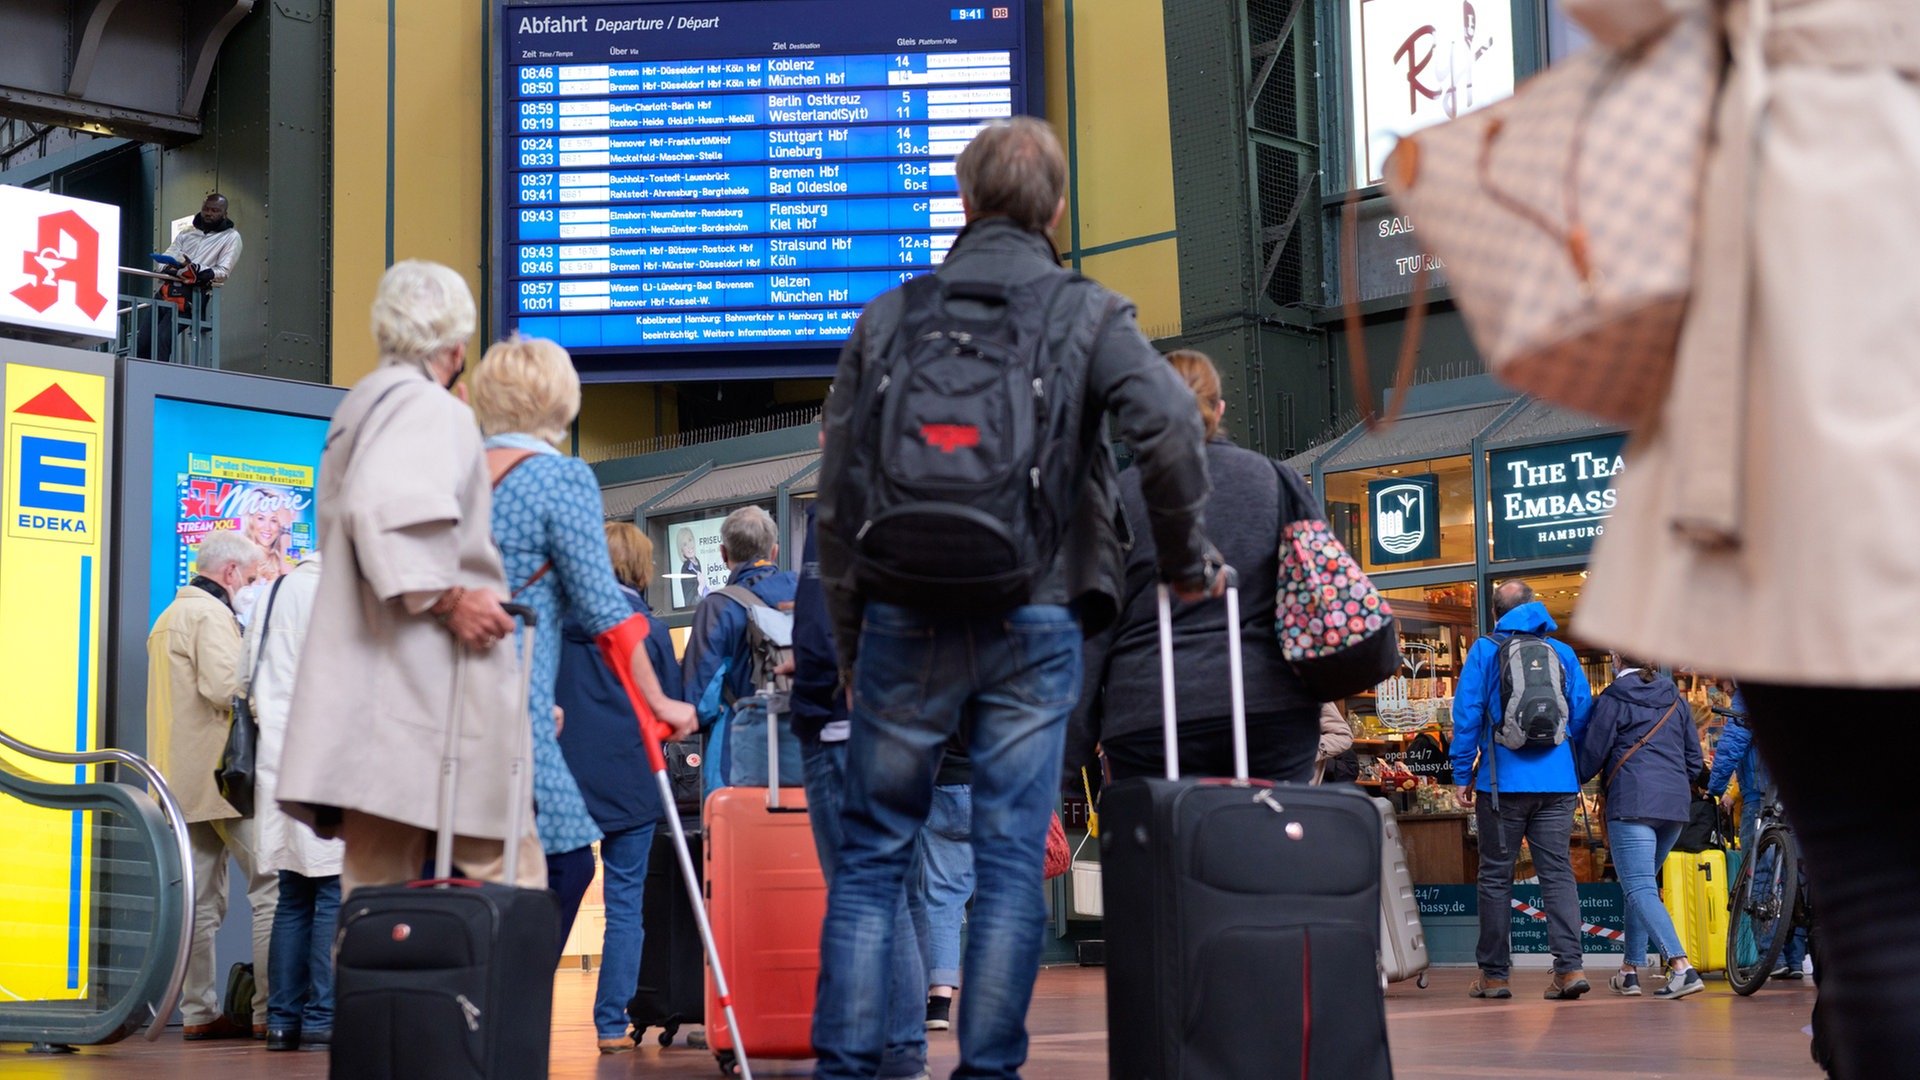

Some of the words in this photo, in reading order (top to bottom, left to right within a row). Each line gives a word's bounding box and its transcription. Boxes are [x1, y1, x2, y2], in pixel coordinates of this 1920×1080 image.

[960, 9, 980, 19] 9:41
[993, 9, 1007, 17] DB
[519, 16, 587, 33] Abfahrt
[595, 18, 663, 33] Departure
[667, 16, 674, 29] /
[677, 17, 719, 31] Départ
[773, 42, 787, 50] Ziel
[897, 38, 916, 46] Gleis
[610, 46, 628, 55] Über
[768, 59, 814, 71] Koblenz
[896, 56, 909, 67] 14
[522, 67, 553, 79] 08:46
[610, 68, 639, 76] Bremen
[642, 65, 704, 75] Hbf-Düsseldorf
[707, 64, 743, 73] Hbf-Köln
[747, 64, 760, 72] Hbf
[610, 83, 639, 92] Bremen
[643, 80, 704, 90] Hbf-Düsseldorf
[708, 79, 744, 88] Hbf-Köln
[747, 78, 761, 86] Hbf
[769, 74, 820, 86] München
[826, 72, 845, 84] Hbf
[522, 82, 553, 94] 08:50
[769, 95, 801, 107] Berlin
[807, 94, 860, 106] Ostkreuz
[903, 91, 910, 103] 5
[522, 103, 553, 114] 08:59
[610, 102, 694, 112] Berlin-Charlott-Berlin
[698, 101, 711, 109] Hbf
[897, 106, 909, 118] 11
[769, 108, 868, 122] Westerland(Sylt)
[522, 118, 553, 129] 09:19
[610, 117, 664, 127] Itzehoe-Heide
[769, 130, 823, 145] Stuttgart
[829, 129, 848, 141] Hbf
[897, 127, 911, 138] 14
[522, 138, 553, 150] 09:24
[610, 139, 645, 148] Hannover
[610, 152, 722, 163] Meckelfeld-Maschen-Stelle
[770, 146, 822, 159] Lüneburg
[522, 153, 553, 165] 09:33
[610, 172, 730, 184] Buchholz-Tostedt-Lauenbrück
[770, 167, 814, 178] Bremen
[820, 166, 839, 177] Hbf
[522, 174, 553, 186] 09:37
[610, 187, 749, 199] Rahlstedt-Ahrensburg-Bargteheide
[770, 182, 791, 193] Bad
[797, 181, 847, 193] Oldesloe
[522, 189, 552, 201] 09:41
[770, 203, 827, 216] Flensburg
[913, 203, 927, 211] C-F
[522, 210, 553, 222] 09:43
[610, 209, 743, 220] Elmshorn-Neumünster-Rendsburg
[610, 223, 748, 235] Elmshorn-Neumünster-Bordesholm
[770, 218, 791, 230] Kiel
[797, 218, 816, 229] Hbf
[610, 247, 646, 256] Schwerin
[650, 245, 735, 254] Hbf-Bützow-Rostock
[740, 244, 753, 252] Hbf
[770, 239, 826, 251] Stralsund
[832, 238, 852, 249] Hbf
[522, 246, 553, 258] 09:43
[899, 251, 912, 263] 14
[610, 262, 640, 271] Bremen
[644, 259, 742, 270] Hbf-Münster-Düsseldorf
[746, 259, 760, 267] Hbf
[771, 255, 796, 266] Köln
[522, 262, 553, 273] 09:46
[610, 284, 639, 292] Winsen
[716, 281, 754, 289] Bevensen
[771, 276, 810, 287] Uelzen
[522, 282, 553, 294] 09:57
[771, 291, 823, 302] München
[829, 289, 848, 301] Hbf
[523, 298, 552, 309] 10:01
[610, 298, 647, 307] Hannover
[651, 297, 710, 306] Hbf-Kassel-W.
[636, 316, 681, 324] Kabelbrand
[685, 315, 721, 324] Hamburg:
[725, 313, 774, 322] Bahnverkehr
[789, 312, 823, 321] Hamburg
[643, 330, 699, 340] beeinträchtigt.
[738, 328, 791, 336] Informationen
[795, 327, 815, 335] unter
[191, 480, 232, 517] TV
[215, 484, 312, 518] Movie
[1504, 488, 1621, 520] EMBASS
[18, 514, 86, 533] EDEKA
[176, 520, 214, 533] STREAM
[214, 519, 237, 530] XXL
[1538, 526, 1604, 542] HAMBURG
[708, 576, 720, 586] Tel.
[1385, 752, 1408, 762] open
[1410, 748, 1432, 760] 24/7
[1414, 886, 1440, 900] 24/7
[1418, 901, 1466, 914] bassy.de
